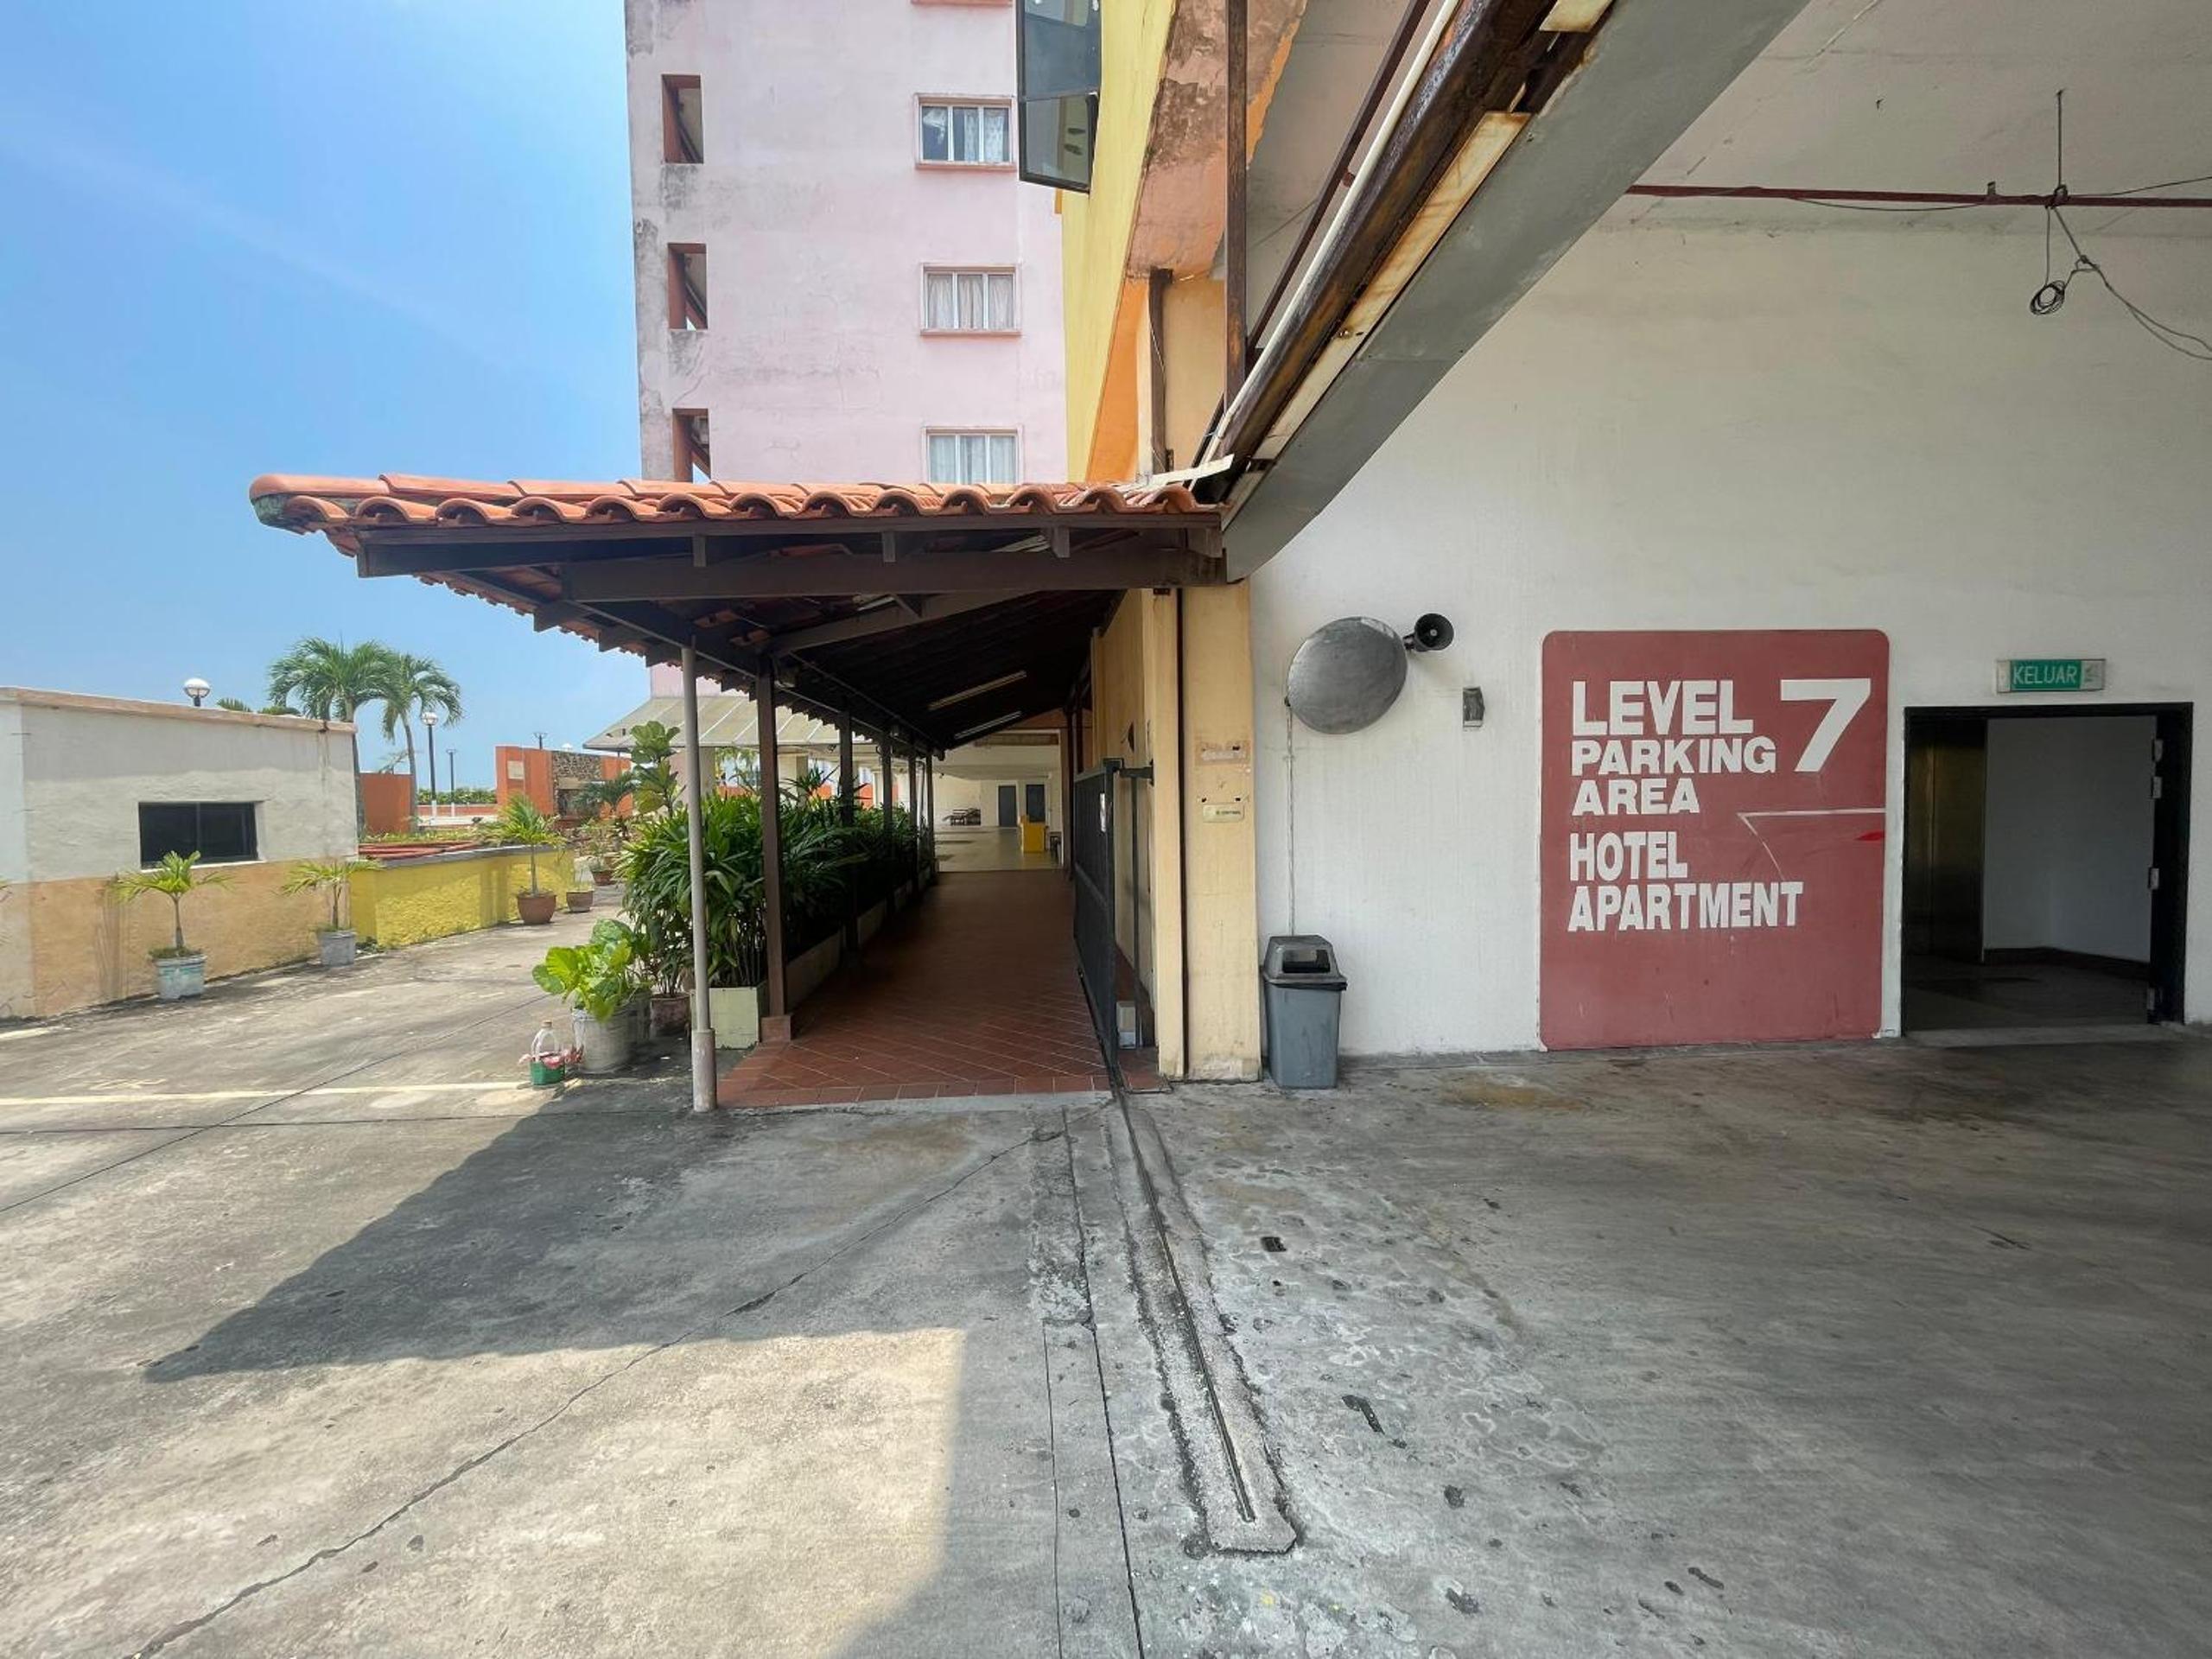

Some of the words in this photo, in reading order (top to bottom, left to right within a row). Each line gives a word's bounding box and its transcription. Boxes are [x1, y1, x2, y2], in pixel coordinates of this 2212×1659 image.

[2012, 665, 2077, 684] KELUAR
[1572, 680, 1754, 736] LEVEL
[1780, 677, 1872, 772] 7
[1571, 736, 1777, 776] PARKING
[1571, 778, 1700, 817] AREA
[1569, 830, 1688, 881] HOTEL
[1567, 881, 1804, 932] APARTMENT
